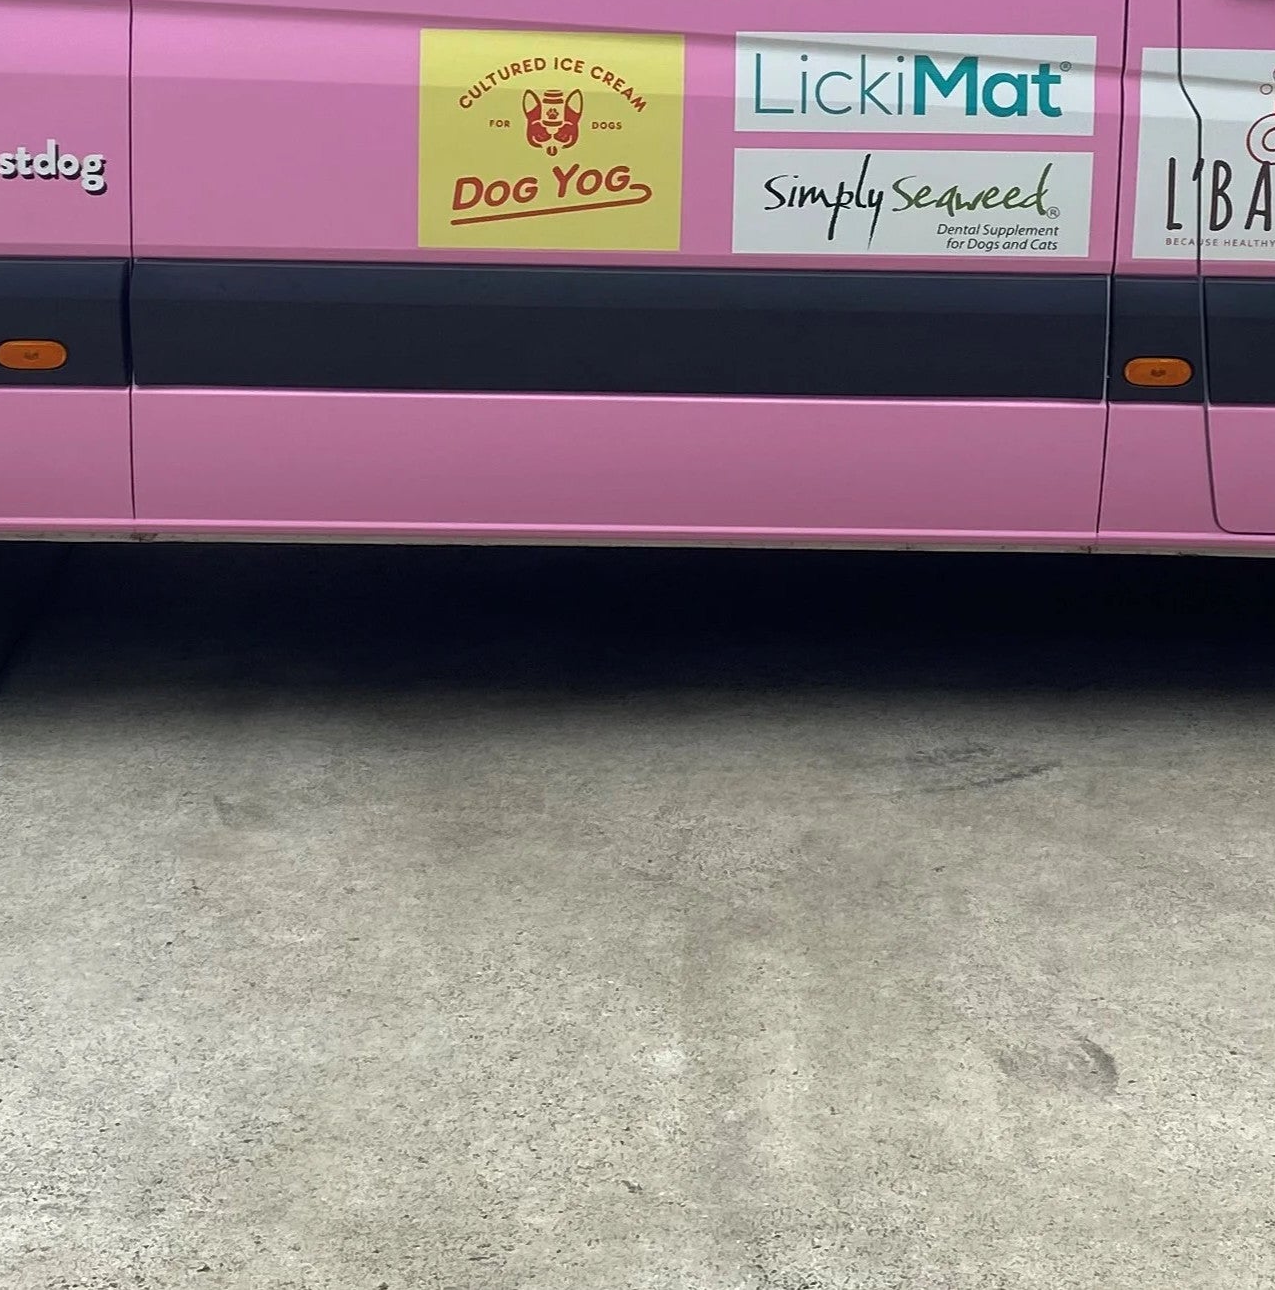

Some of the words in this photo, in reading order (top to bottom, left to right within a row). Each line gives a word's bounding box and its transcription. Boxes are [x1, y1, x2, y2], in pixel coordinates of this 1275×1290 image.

[459, 57, 547, 110] CULTURED
[553, 56, 586, 74] ICE
[590, 66, 647, 112] CREAM
[489, 119, 511, 128] FOR
[591, 121, 623, 130] DOGS
[452, 176, 539, 211] DOG
[552, 163, 631, 198] YOG
[763, 153, 885, 251] Simply
[936, 223, 980, 236] Dental
[982, 224, 1060, 239] Supplement
[945, 236, 965, 252] for
[966, 238, 1000, 253] Dogs
[1001, 238, 1028, 251] and
[1029, 239, 1059, 252] Cats
[1165, 237, 1220, 248] BECAUSE
